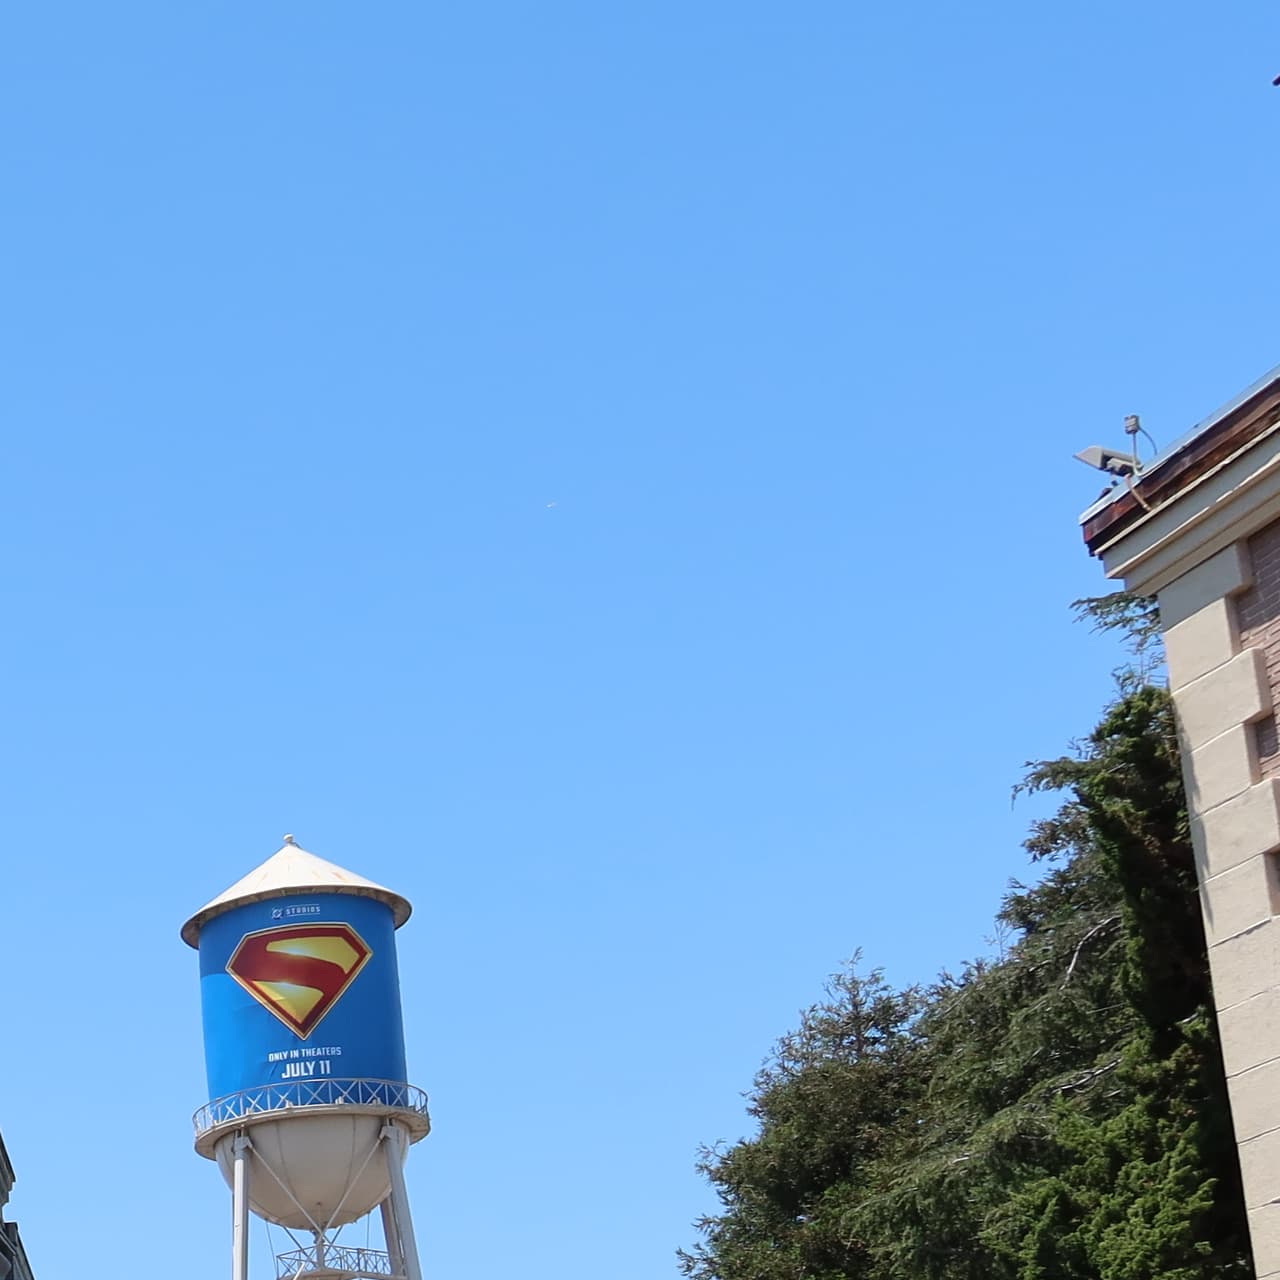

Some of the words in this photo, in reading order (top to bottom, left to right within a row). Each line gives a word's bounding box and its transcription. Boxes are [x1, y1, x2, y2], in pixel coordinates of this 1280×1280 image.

[268, 1050, 289, 1062] ONLY
[290, 1049, 300, 1059] IN
[301, 1046, 342, 1058] THEATERS
[281, 1060, 316, 1079] JULY
[319, 1059, 331, 1075] 11
